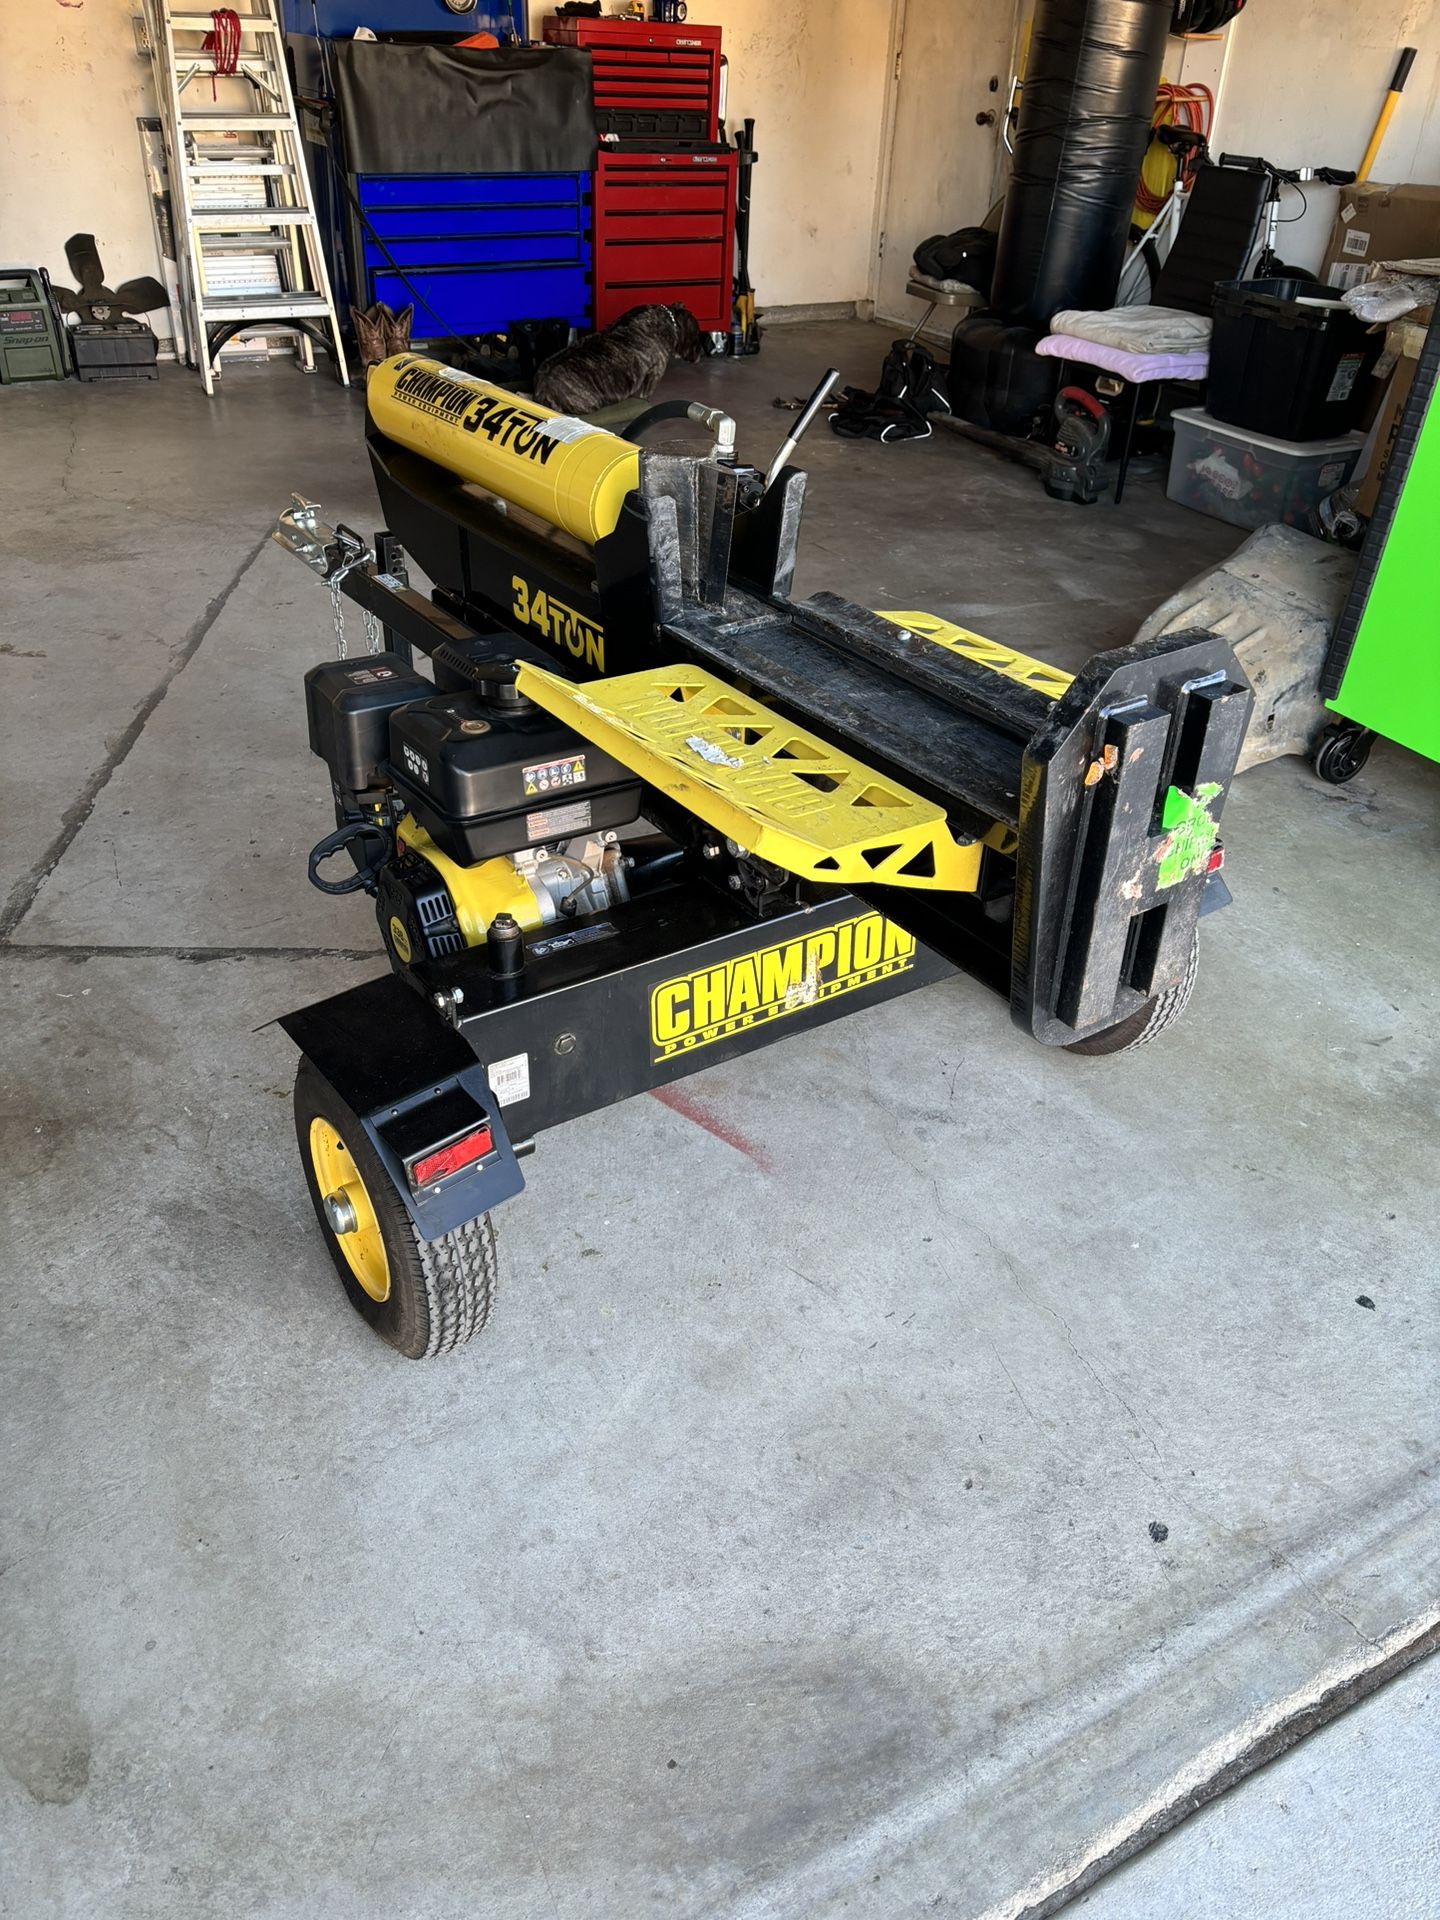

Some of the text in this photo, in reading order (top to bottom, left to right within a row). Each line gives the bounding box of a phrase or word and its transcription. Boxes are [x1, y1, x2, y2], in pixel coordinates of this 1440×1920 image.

[396, 368, 480, 417] CHAMPION
[655, 913, 913, 1043] CHAMPION
[664, 958, 908, 1055] POWER EIPMENT
